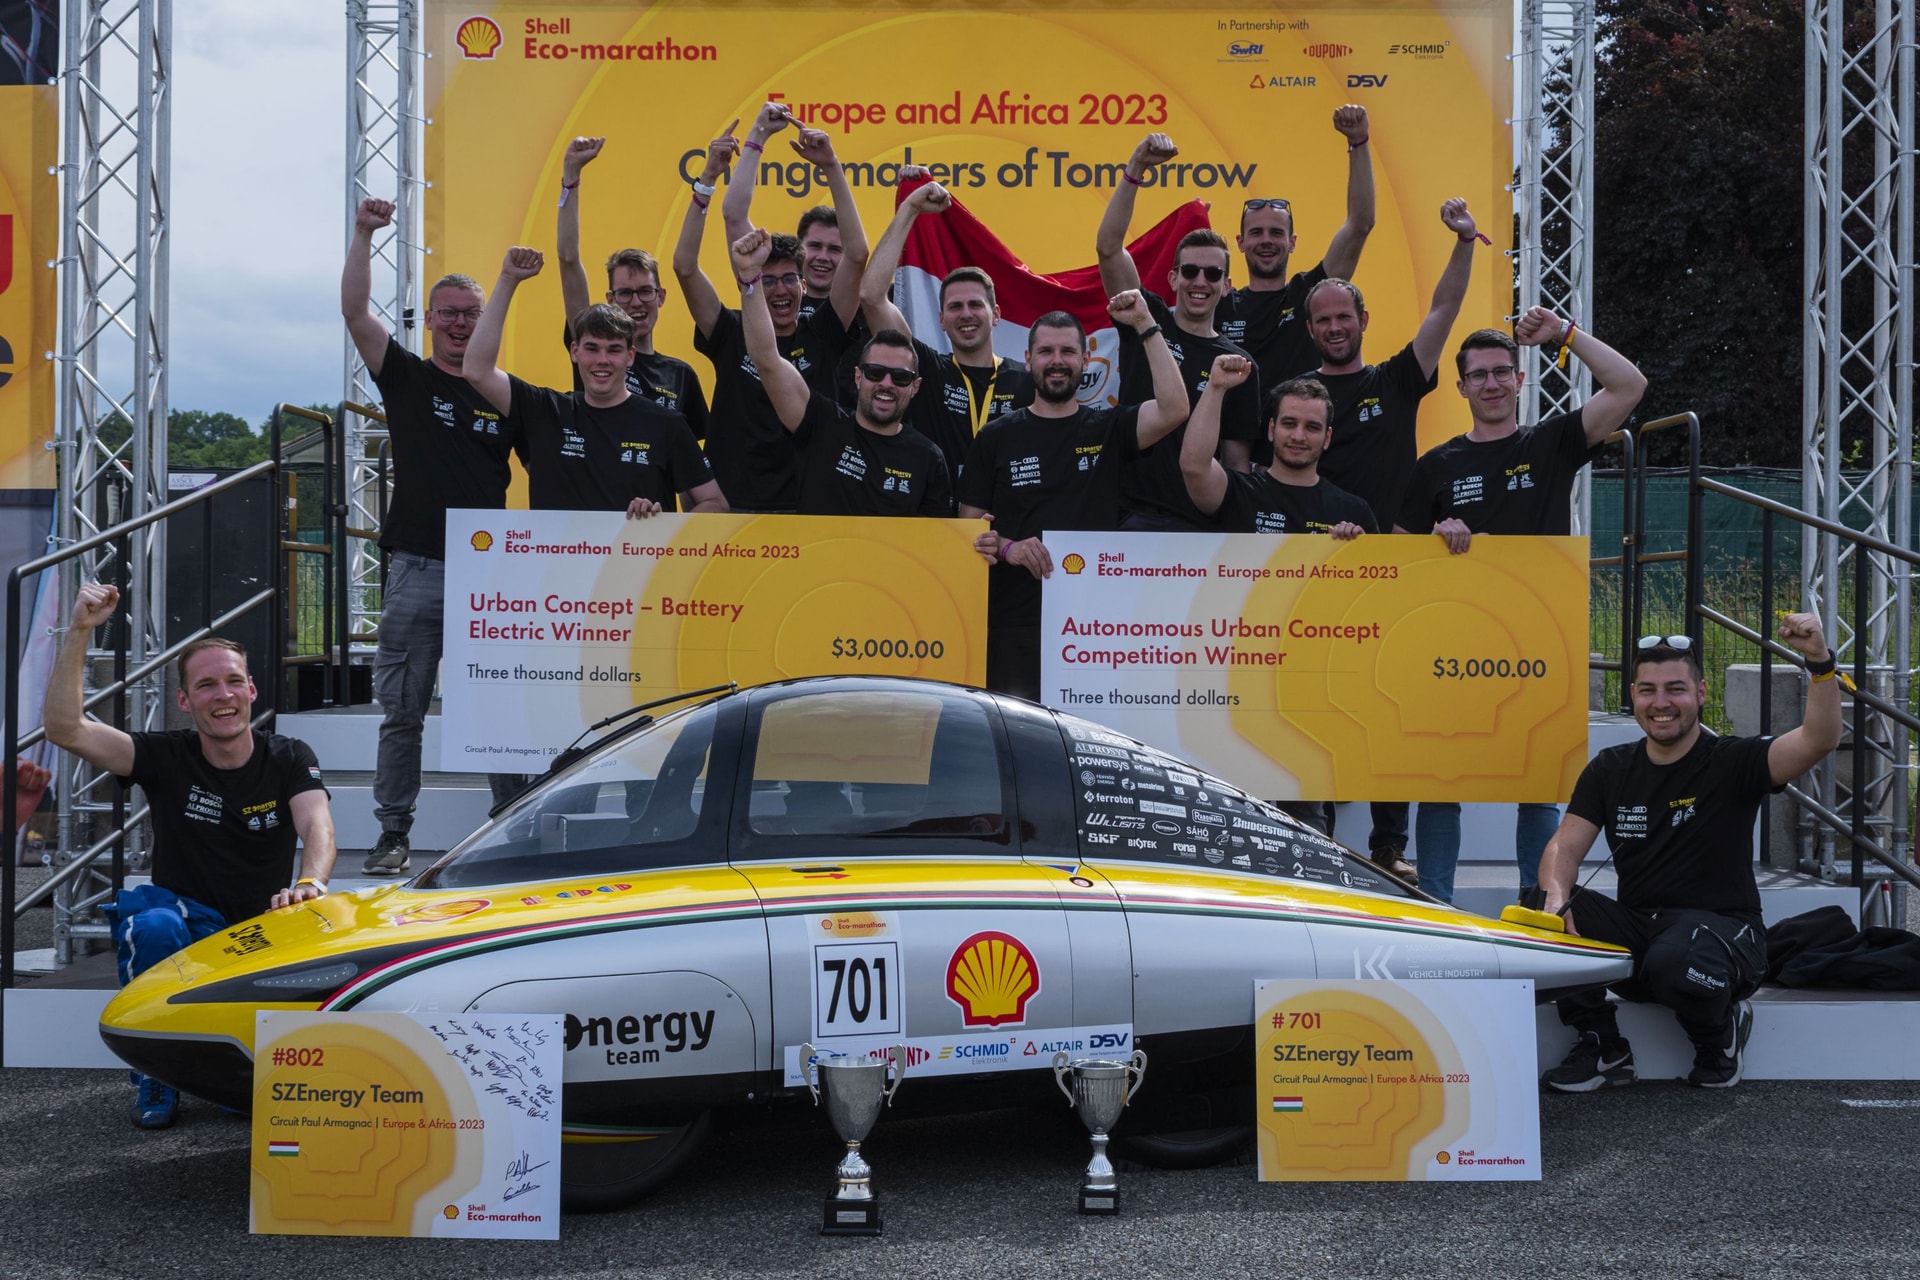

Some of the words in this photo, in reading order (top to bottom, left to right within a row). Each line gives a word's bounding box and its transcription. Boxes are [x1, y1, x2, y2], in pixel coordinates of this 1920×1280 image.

[524, 18, 570, 35] Shell
[1218, 20, 1227, 31] In
[1230, 20, 1286, 33] Partnership
[1288, 20, 1310, 31] with
[524, 38, 718, 62] Eco-marathon
[1230, 44, 1264, 56] SwRI
[1308, 44, 1348, 58] DUPONT
[1402, 44, 1445, 54] SCHMID
[1269, 76, 1316, 87] ALTAIR
[1347, 75, 1388, 88] DSV
[768, 93, 886, 134] urope
[895, 92, 961, 125] and
[970, 91, 1069, 126] Africa
[1078, 94, 1168, 126] 2023
[678, 147, 986, 198] Cngemaers
[997, 146, 1039, 188] of
[1046, 152, 1258, 188] Tomorrow
[1020, 464, 1040, 472] BOSCH
[1462, 482, 1482, 490] BOSCH
[1264, 520, 1285, 528] BOSCH
[506, 530, 532, 541] Shell
[505, 541, 612, 556] Eco-marathon
[622, 542, 674, 559] Europe
[678, 542, 709, 558] and
[712, 544, 756, 558] Africa
[760, 544, 800, 559] 2023
[1098, 552, 1124, 563] Shell
[1098, 562, 1208, 578] Eco-marathon
[1218, 565, 1272, 580] Europe
[1276, 564, 1305, 579] and
[1309, 564, 1354, 580] Africa
[1358, 566, 1399, 580] 2023
[470, 593, 538, 614] Urban
[544, 594, 634, 620] Concept
[661, 597, 744, 622] Battery
[468, 620, 546, 642] Electric
[551, 622, 632, 642] Winner
[1061, 616, 1204, 639] Autonomous
[1211, 618, 1281, 639] Urban
[1288, 618, 1381, 645] Concept
[831, 636, 945, 662] $3,000.00
[1061, 644, 1198, 671] Competition
[1204, 646, 1287, 666] Winner
[466, 663, 508, 681] Three
[513, 664, 584, 682] thousand
[588, 664, 642, 684] dollars
[1432, 656, 1547, 681] $3,000.00
[1060, 688, 1104, 705] Three
[1108, 688, 1182, 706] thousand
[1186, 689, 1240, 707] dollars
[464, 746, 487, 754] Circuit
[488, 746, 502, 754] Paul
[505, 746, 540, 756] Armagnac
[1076, 756, 1130, 772] powersys
[200, 796, 222, 809] BOSCH
[1096, 792, 1134, 804] ferroton
[186, 802, 222, 818] ALPROSYS
[1232, 816, 1294, 840] BRIDGESTONE
[1088, 832, 1120, 844] SKF
[838, 921, 887, 931] Eco-marathon
[1408, 970, 1443, 978] VEHICLE
[1444, 968, 1485, 978] INDUSTRY
[1688, 967, 1706, 980] Black
[822, 956, 888, 1024] 701
[1272, 1012, 1285, 1029] #
[1289, 1012, 1322, 1029] 701
[1040, 1040, 1082, 1052] ALTAIR
[1090, 1032, 1128, 1048] DSV
[272, 1048, 324, 1068] #802
[606, 1047, 660, 1065] team
[956, 1043, 1008, 1058] SCHMID
[1273, 1044, 1360, 1066] SZEnergy
[1364, 1044, 1414, 1062] Team
[972, 1056, 1008, 1065] Elektronik
[1273, 1074, 1300, 1084] Circuit
[1302, 1074, 1320, 1084] Paul
[1322, 1074, 1368, 1086] Armagnac
[1376, 1074, 1408, 1086] Europe
[1410, 1074, 1417, 1084] &
[1418, 1074, 1444, 1084] Africa
[1446, 1074, 1470, 1084] 2023
[272, 1082, 366, 1108] SZEnergy
[370, 1084, 424, 1104] Team
[270, 1116, 300, 1128] Circuit
[302, 1116, 320, 1128] Paul
[322, 1118, 373, 1131] Armagnac
[382, 1118, 416, 1132] Europe
[418, 1119, 427, 1130] &
[428, 1118, 456, 1130] Africa
[458, 1120, 486, 1130] 2023
[1458, 1156, 1526, 1166] Eco-marathon
[468, 1204, 486, 1212] Shell
[467, 1212, 542, 1223] Eco-marathon
